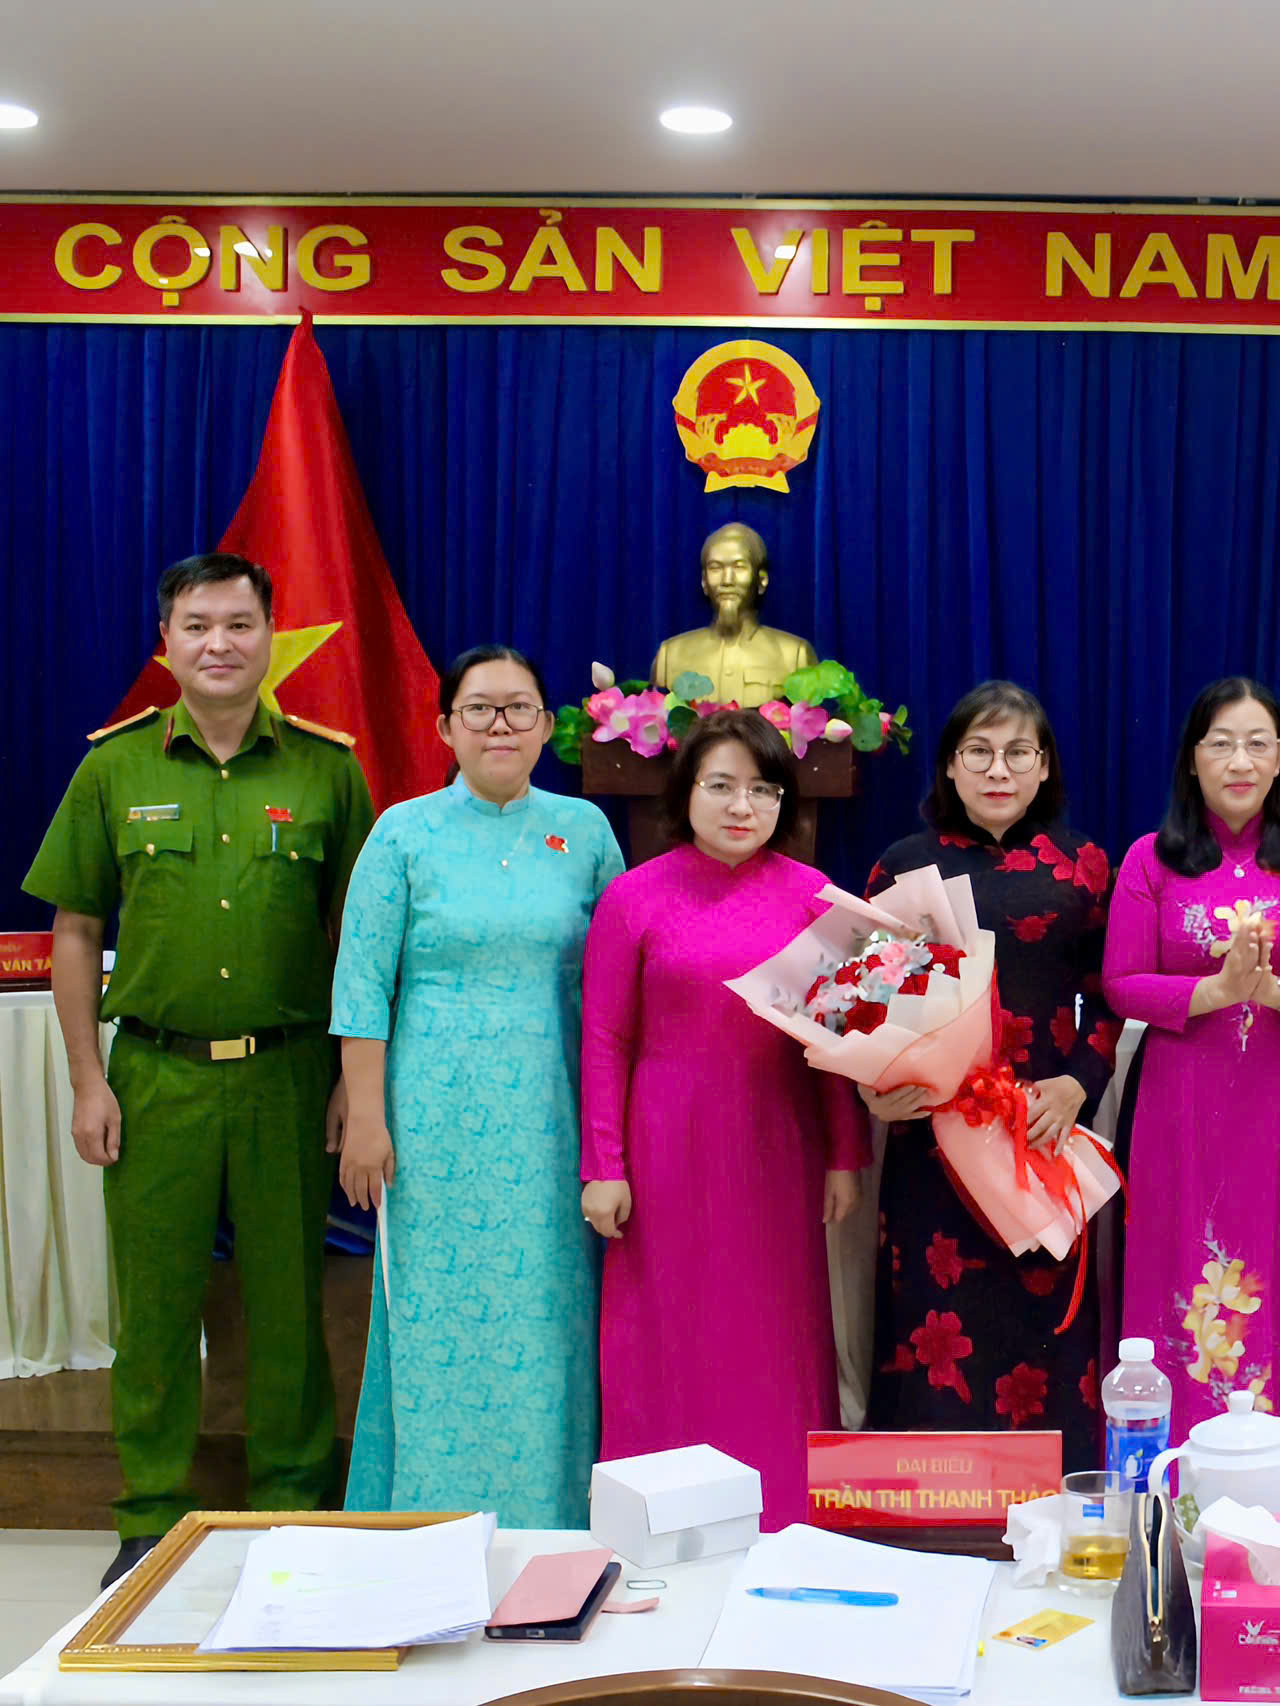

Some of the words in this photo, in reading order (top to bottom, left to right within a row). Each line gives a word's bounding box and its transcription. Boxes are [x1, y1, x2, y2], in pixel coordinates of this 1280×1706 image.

[56, 214, 371, 306] CỘNG
[440, 208, 663, 294] SẢN
[731, 220, 975, 312] VIỆT
[916, 1489, 992, 1509] THANH
